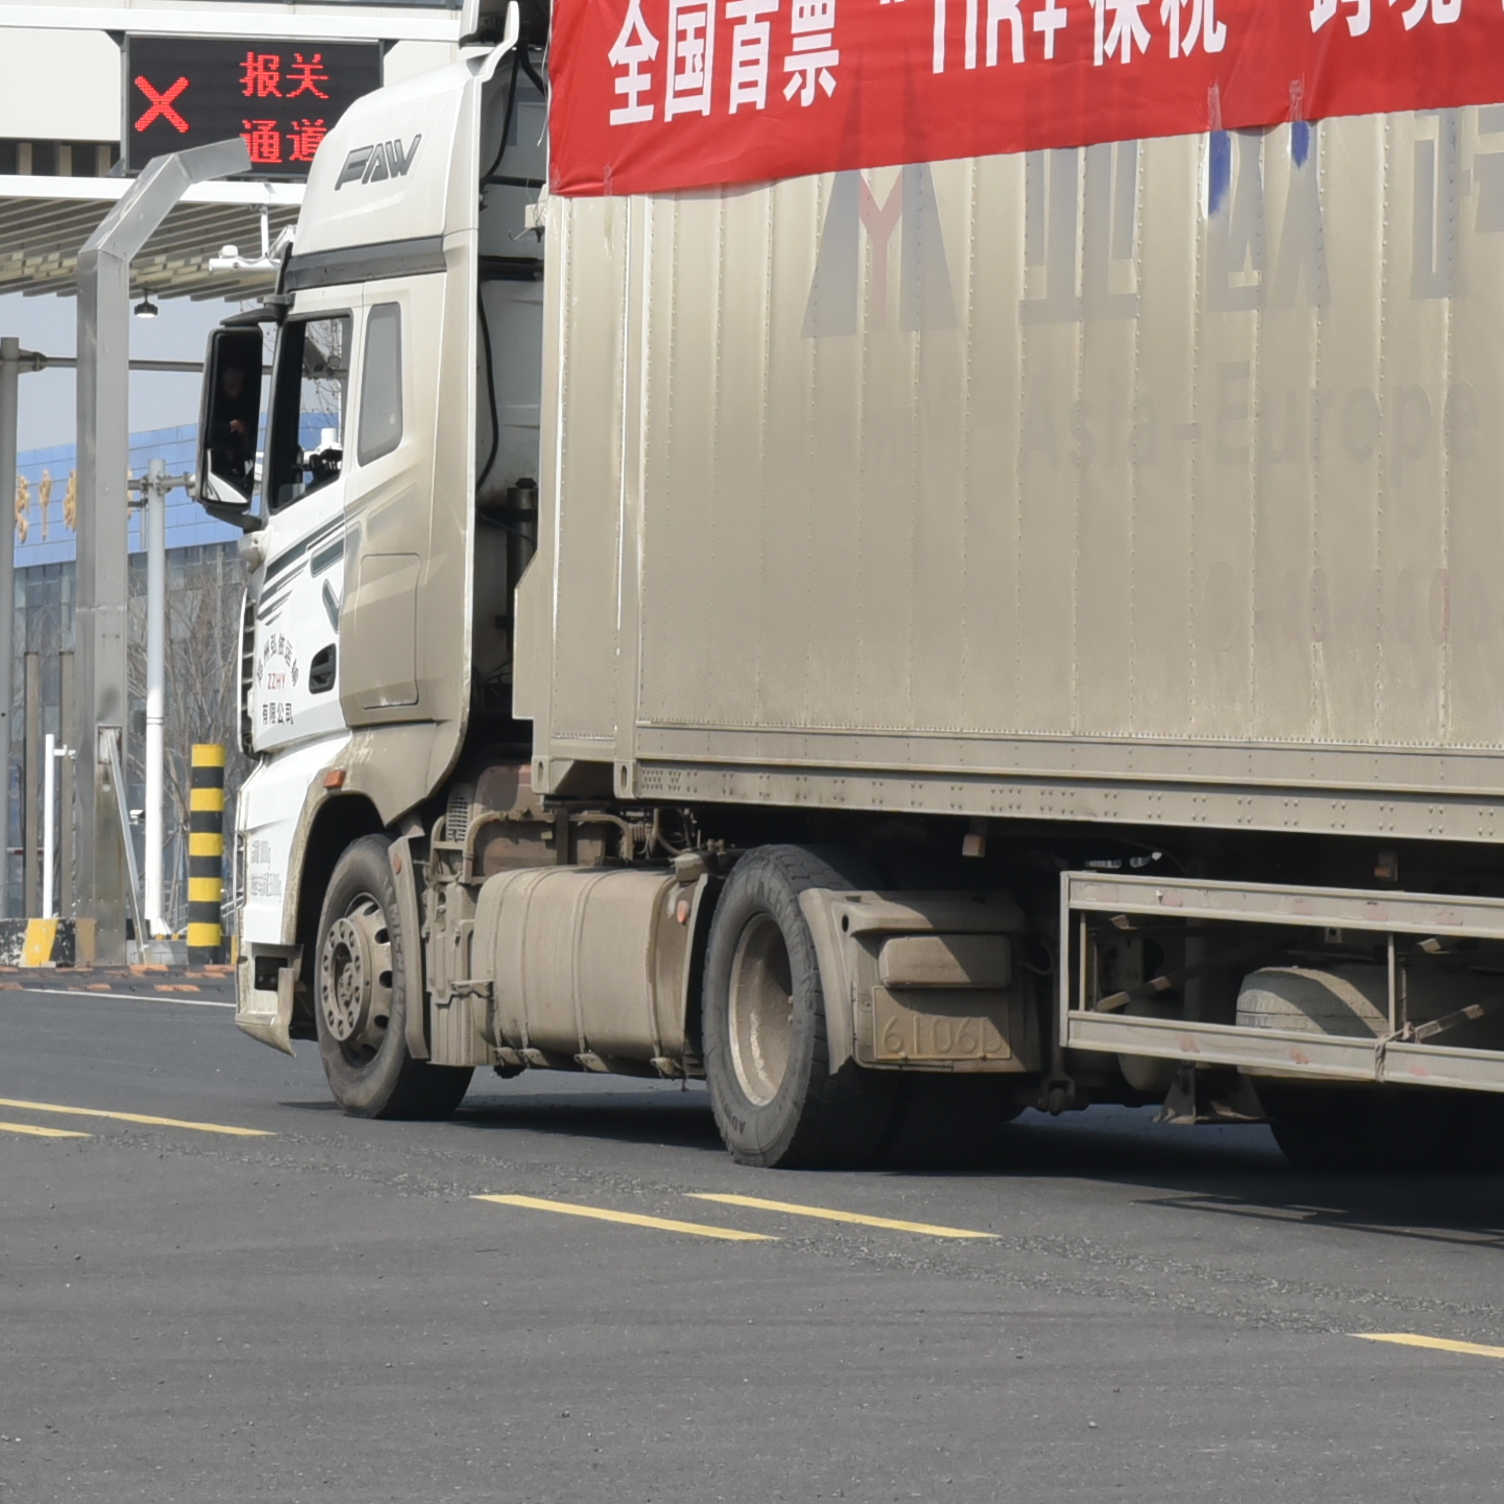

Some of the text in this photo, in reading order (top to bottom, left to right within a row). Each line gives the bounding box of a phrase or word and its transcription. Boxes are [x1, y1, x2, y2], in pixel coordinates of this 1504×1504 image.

[239, 51, 330, 100] 报关
[239, 118, 329, 164] 通道
[334, 133, 422, 192] FAW
[267, 672, 287, 690] ZZHY
[261, 701, 295, 726] 有限公司
